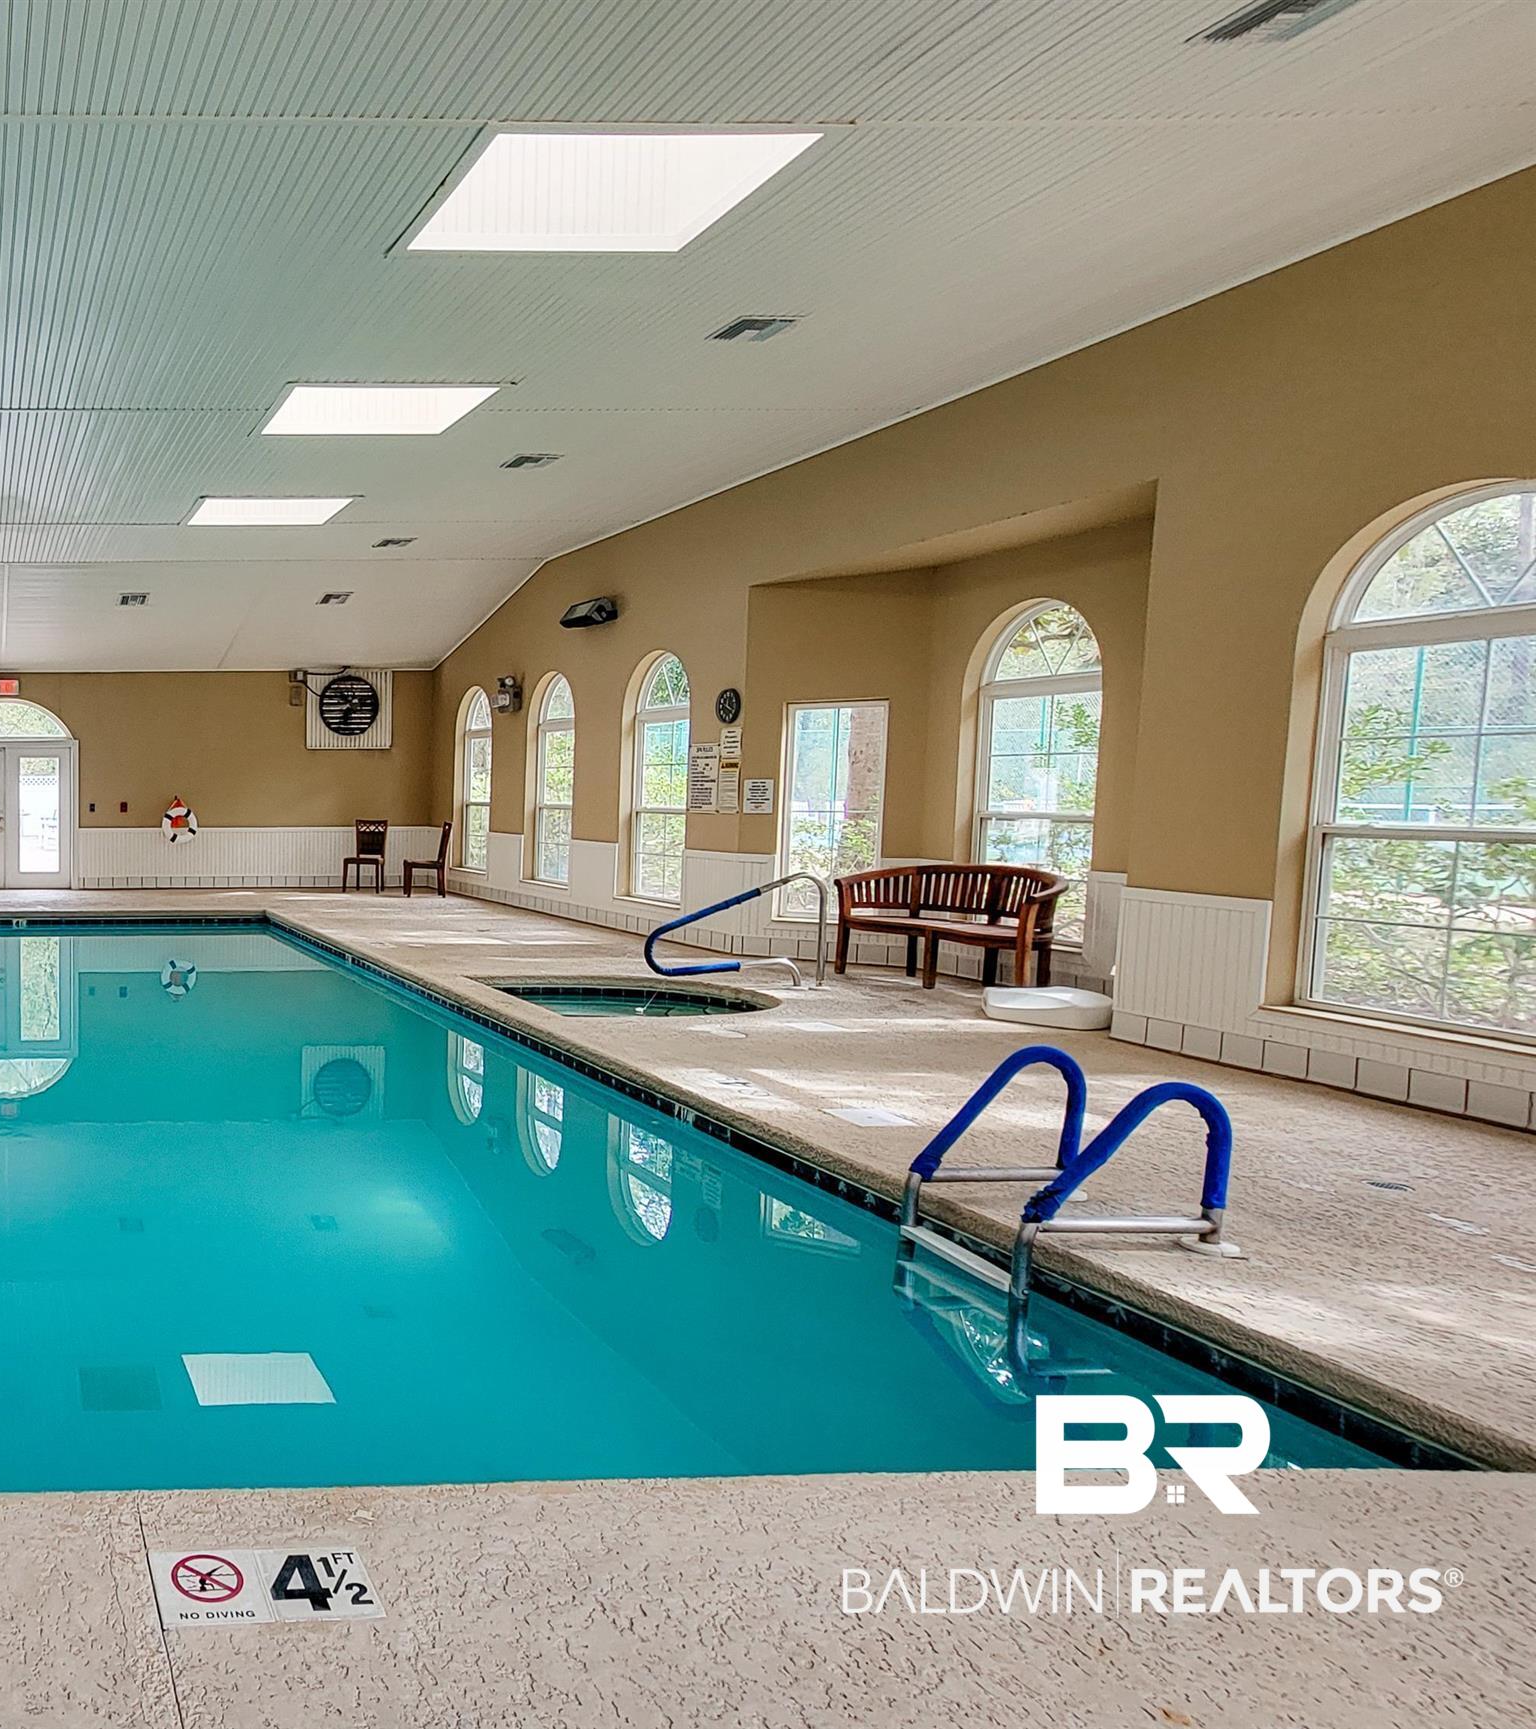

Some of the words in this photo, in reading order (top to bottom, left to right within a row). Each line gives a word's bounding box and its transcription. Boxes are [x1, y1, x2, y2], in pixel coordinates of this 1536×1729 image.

[330, 1552, 355, 1565] FT
[270, 1554, 334, 1612] 4
[179, 1611, 201, 1620] NO
[206, 1609, 256, 1619] DIVING
